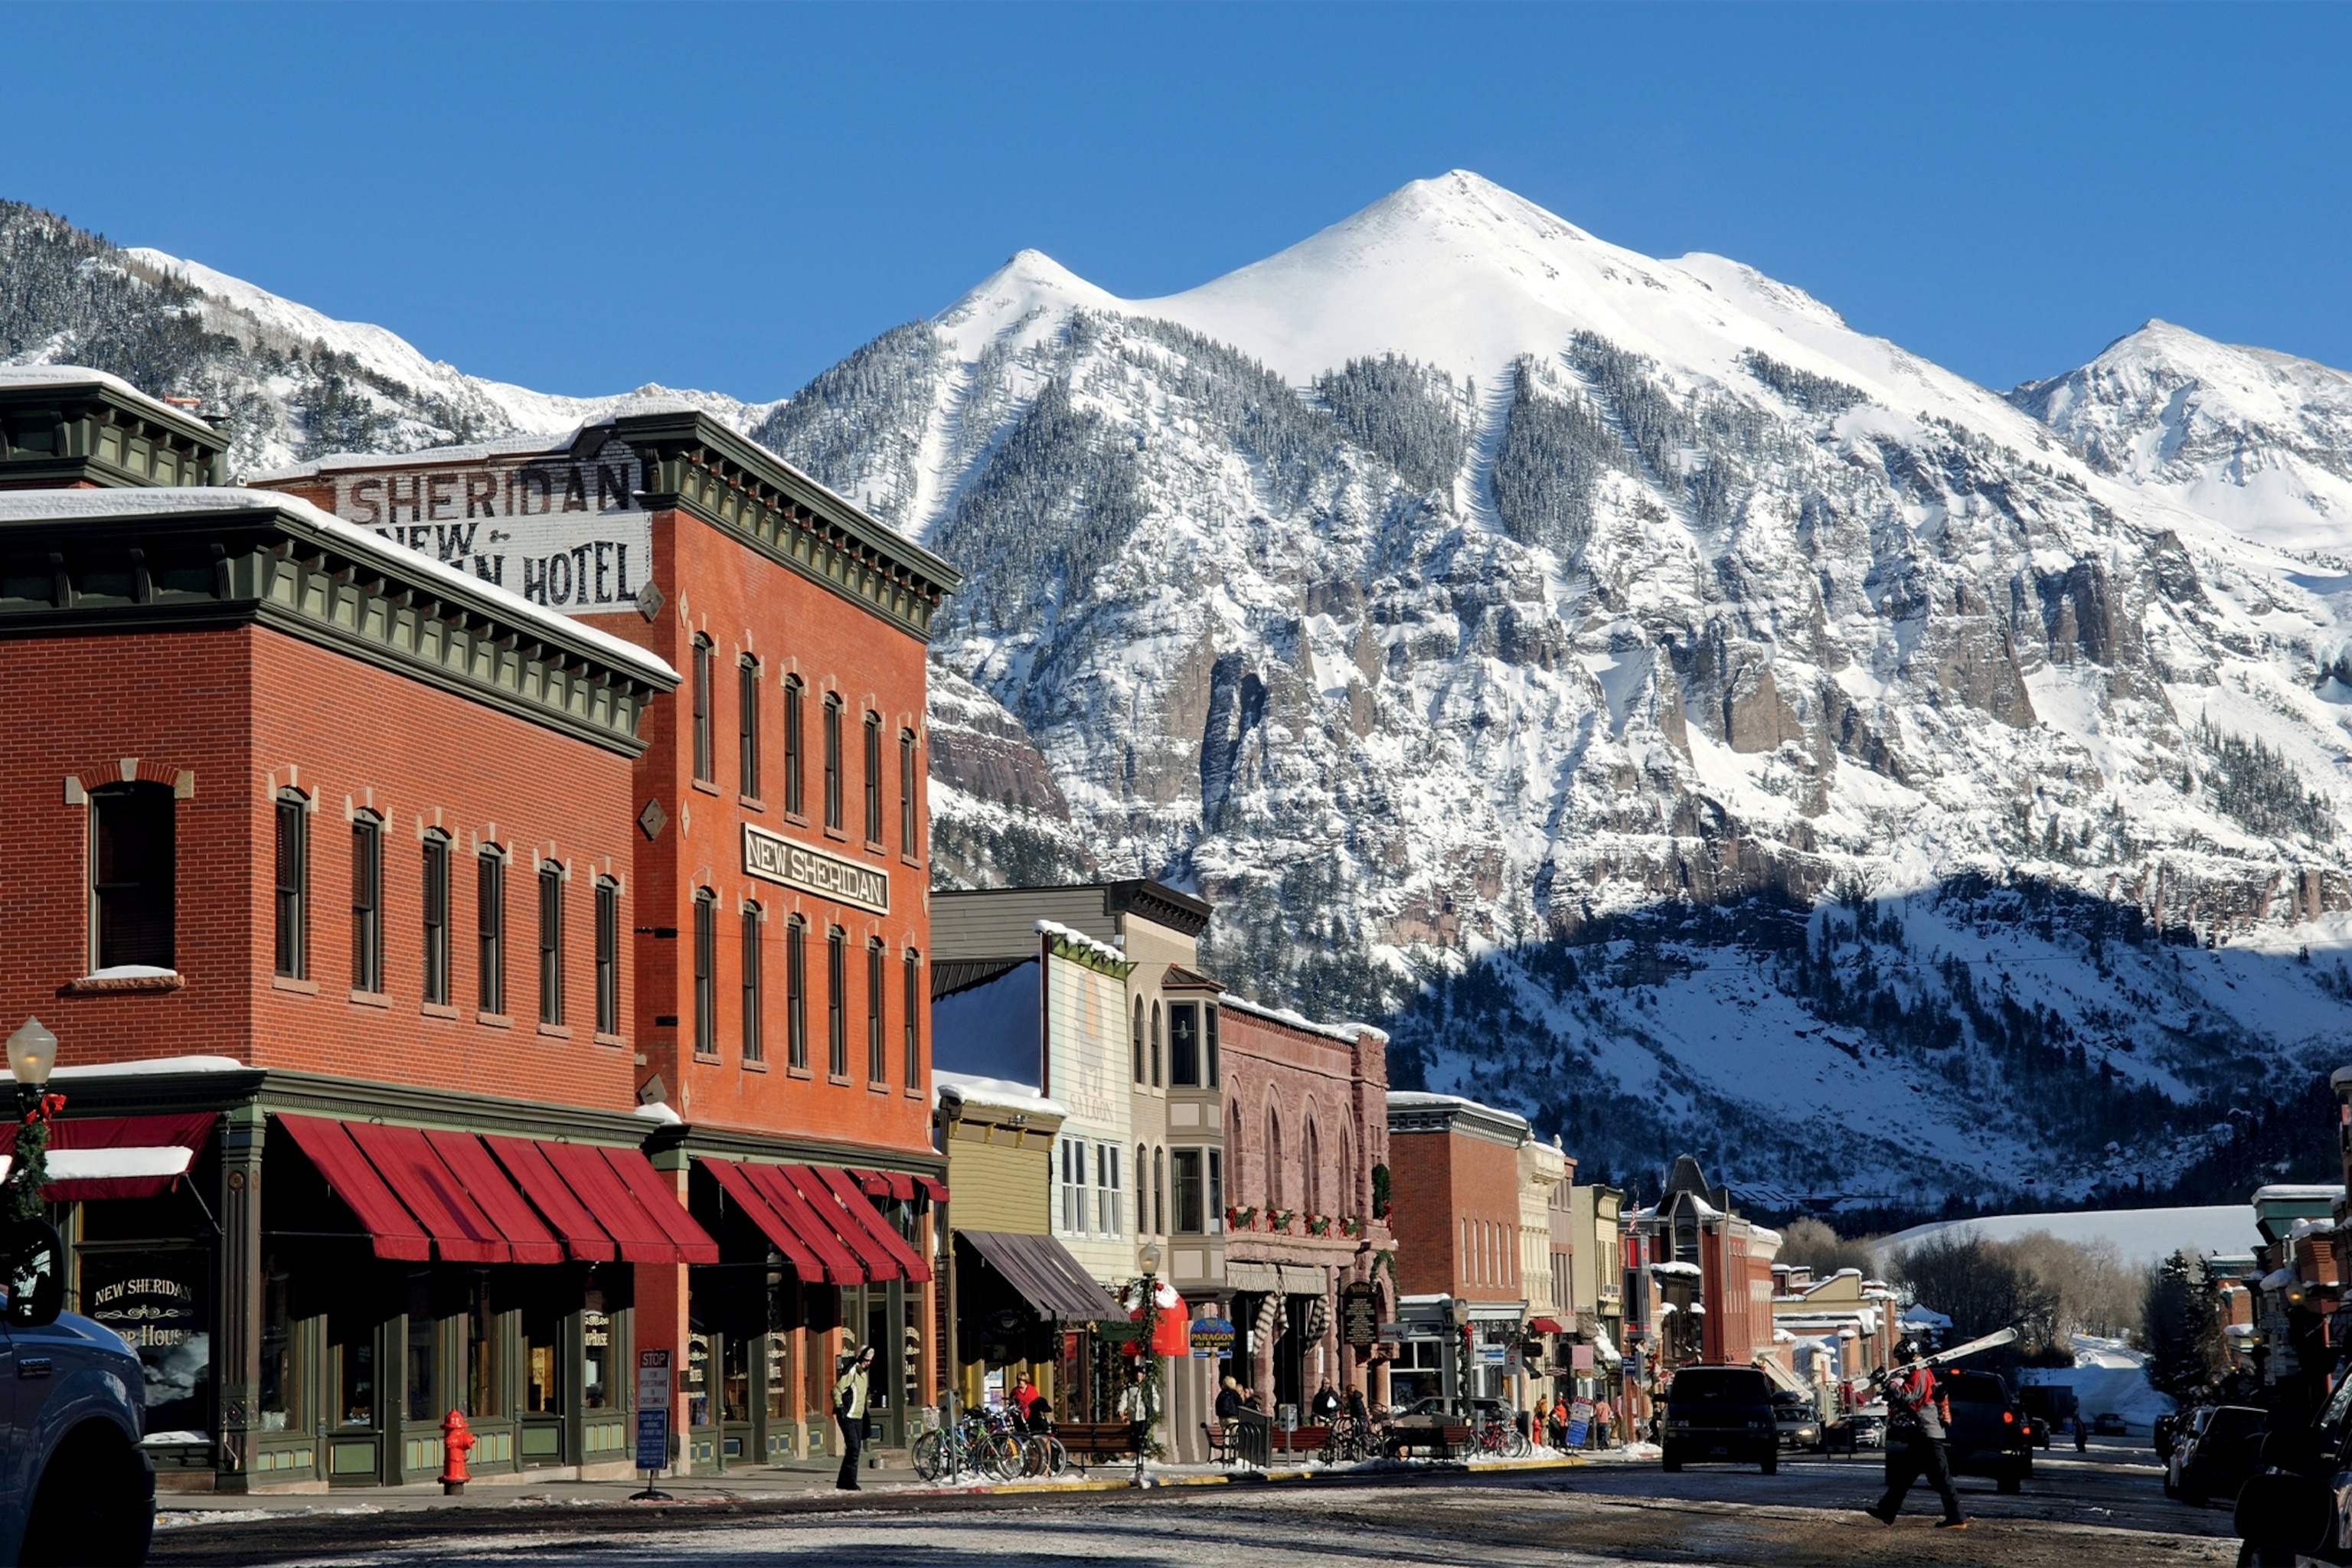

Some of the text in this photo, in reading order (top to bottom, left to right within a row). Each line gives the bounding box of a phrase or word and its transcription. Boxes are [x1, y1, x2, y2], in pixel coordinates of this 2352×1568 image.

[350, 462, 630, 525] SHERIDAN
[523, 540, 637, 606] HOTEL
[747, 833, 882, 905] NEW SHERIDAN
[1070, 1093, 1114, 1125] SALOON
[95, 1278, 192, 1305] NEW SHERIDAN
[140, 1325, 193, 1347] HOUSE
[1191, 1333, 1234, 1341] PARAGON
[642, 1352, 666, 1366] STOP
